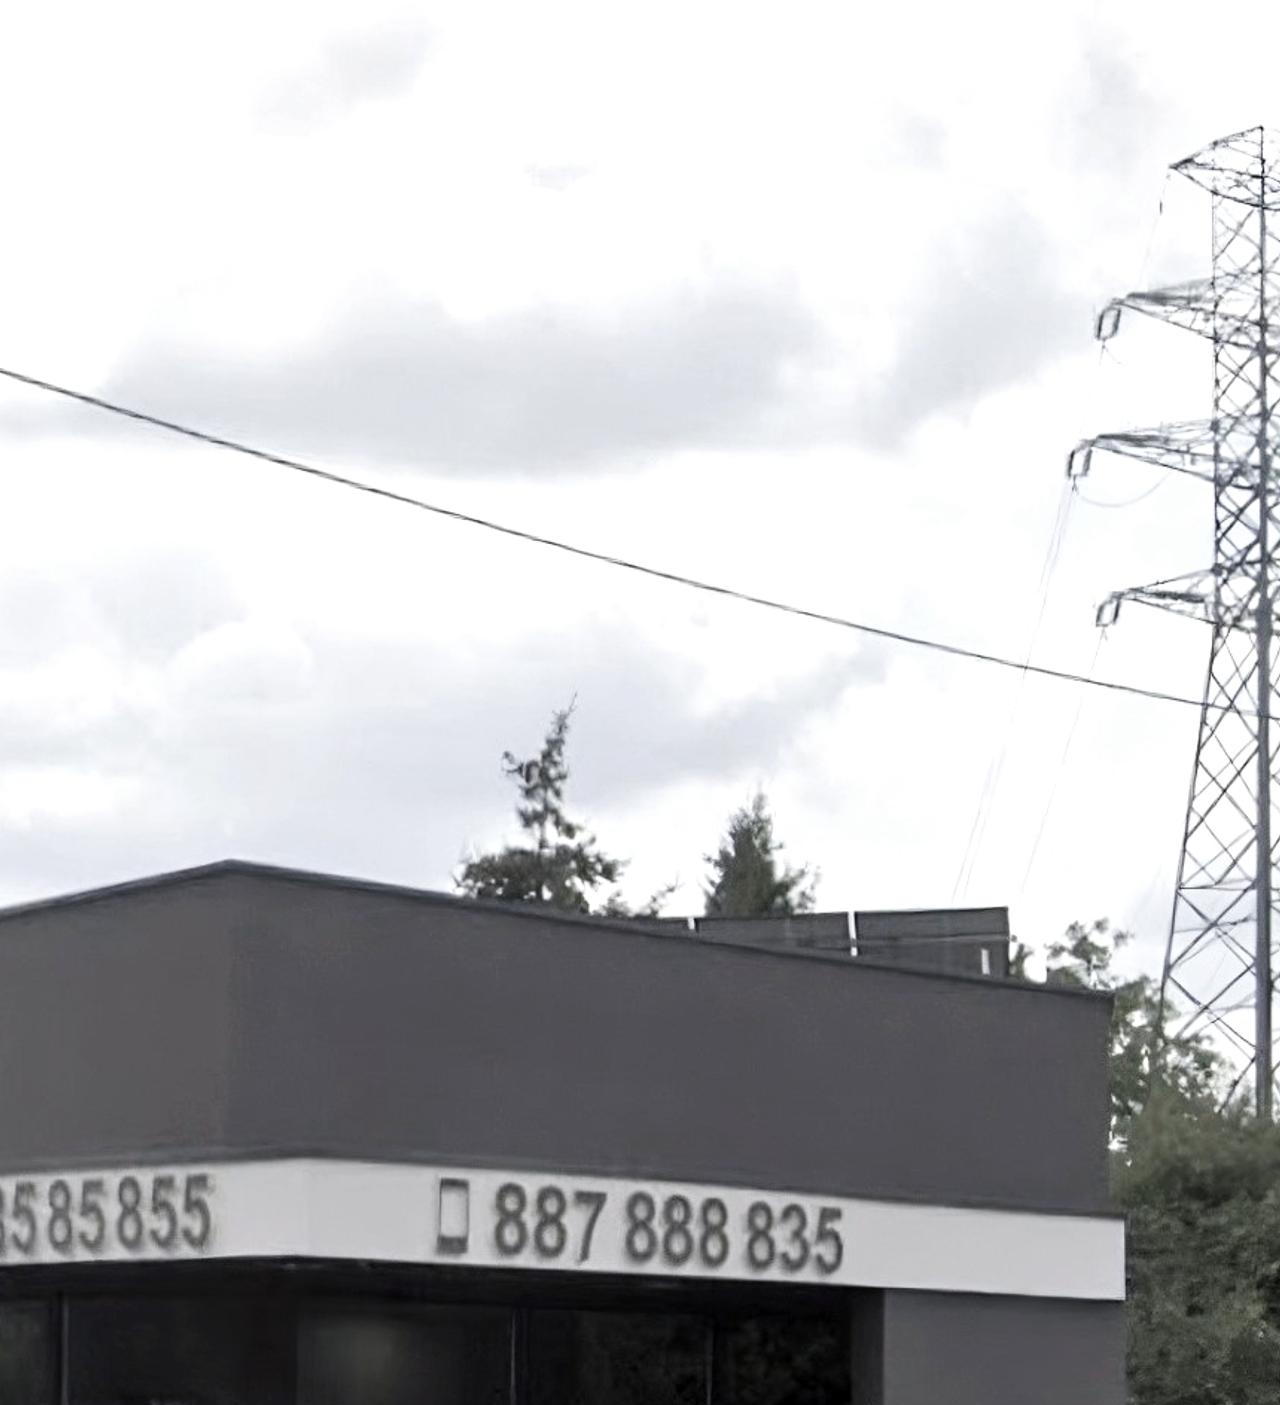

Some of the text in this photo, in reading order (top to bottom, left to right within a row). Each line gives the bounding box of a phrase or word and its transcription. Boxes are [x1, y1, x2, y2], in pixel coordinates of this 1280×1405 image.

[494, 1182, 844, 1275] 887 888 835
